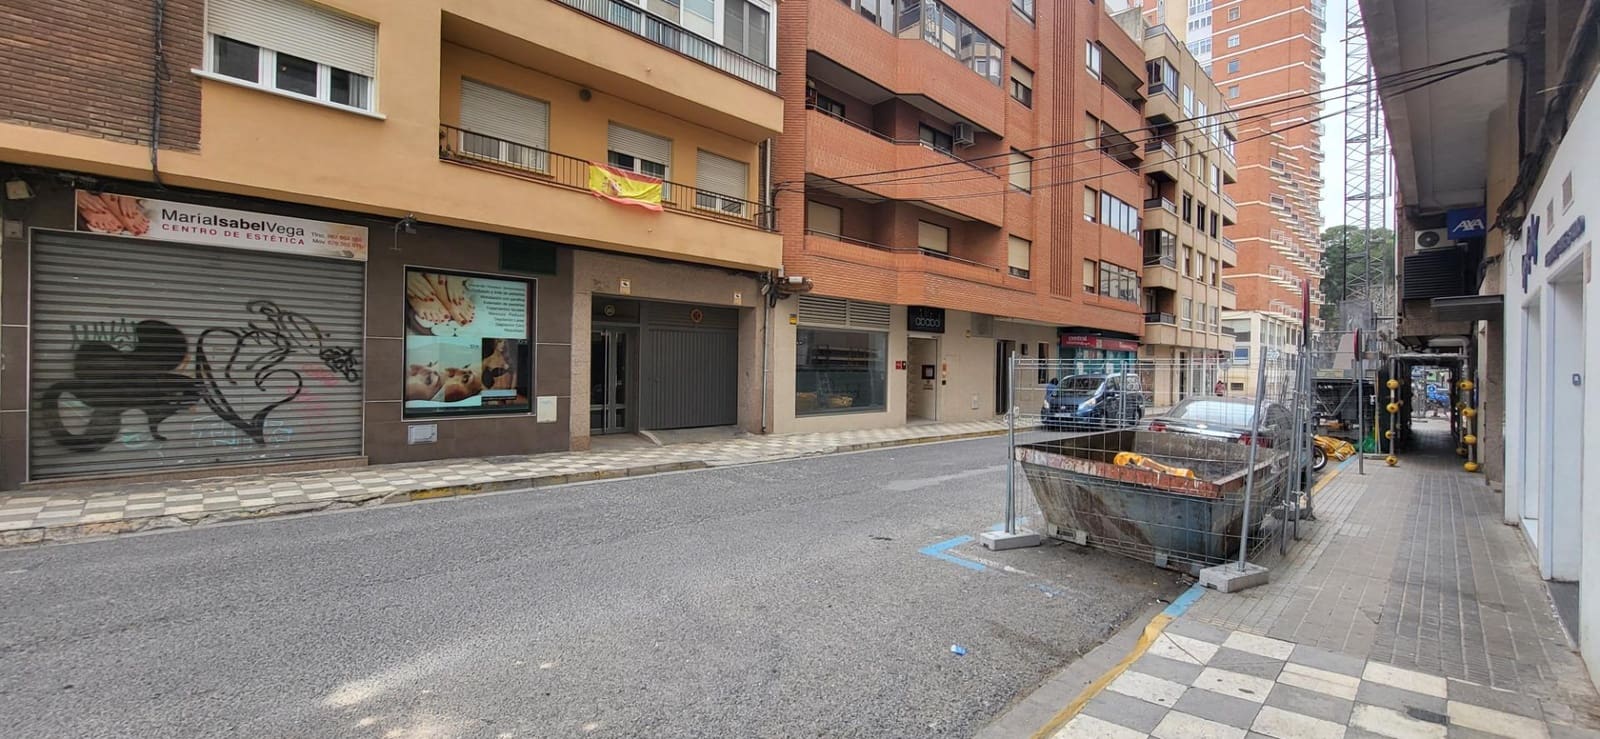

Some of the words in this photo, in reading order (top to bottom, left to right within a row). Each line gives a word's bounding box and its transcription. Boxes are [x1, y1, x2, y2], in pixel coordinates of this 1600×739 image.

[1452, 218, 1485, 232] AXA
[162, 223, 218, 236] CENTRO
[224, 230, 240, 238] DE
[246, 232, 305, 246] ESTÉTICA
